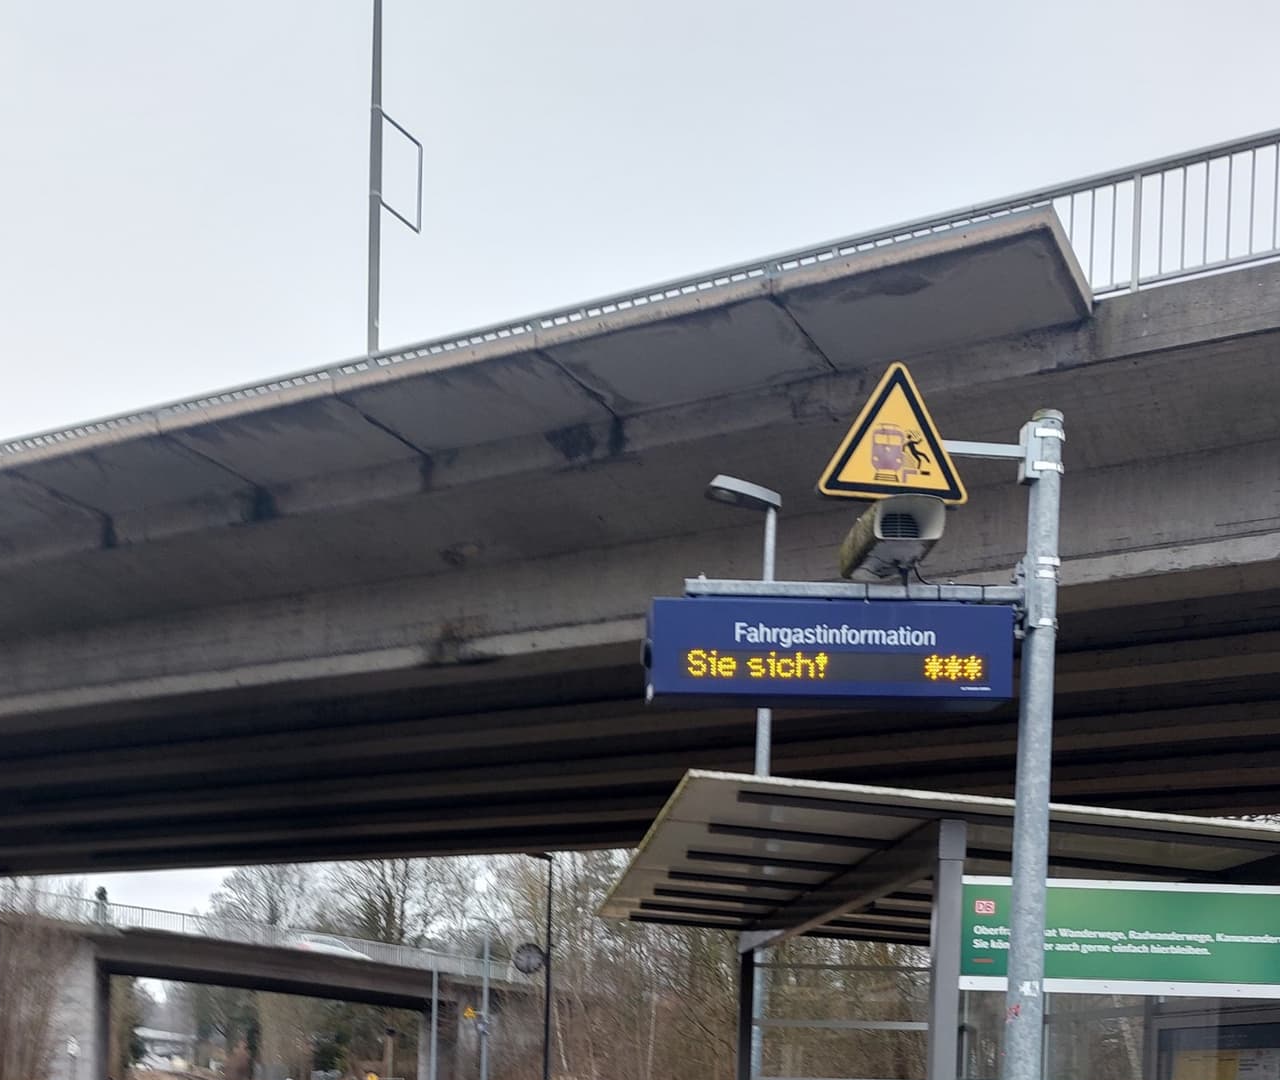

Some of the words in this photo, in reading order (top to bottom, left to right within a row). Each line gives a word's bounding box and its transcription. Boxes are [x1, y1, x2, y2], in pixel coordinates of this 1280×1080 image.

[734, 621, 937, 648] Fahrgastinformation
[687, 649, 736, 677] Sie
[746, 651, 828, 678] sich!
[976, 901, 994, 912] DB
[973, 925, 1012, 936] Oberfr
[972, 939, 989, 949] Sie
[1055, 942, 1080, 951] auch
[1081, 944, 1111, 954] gerne
[1112, 943, 1149, 953] einfach
